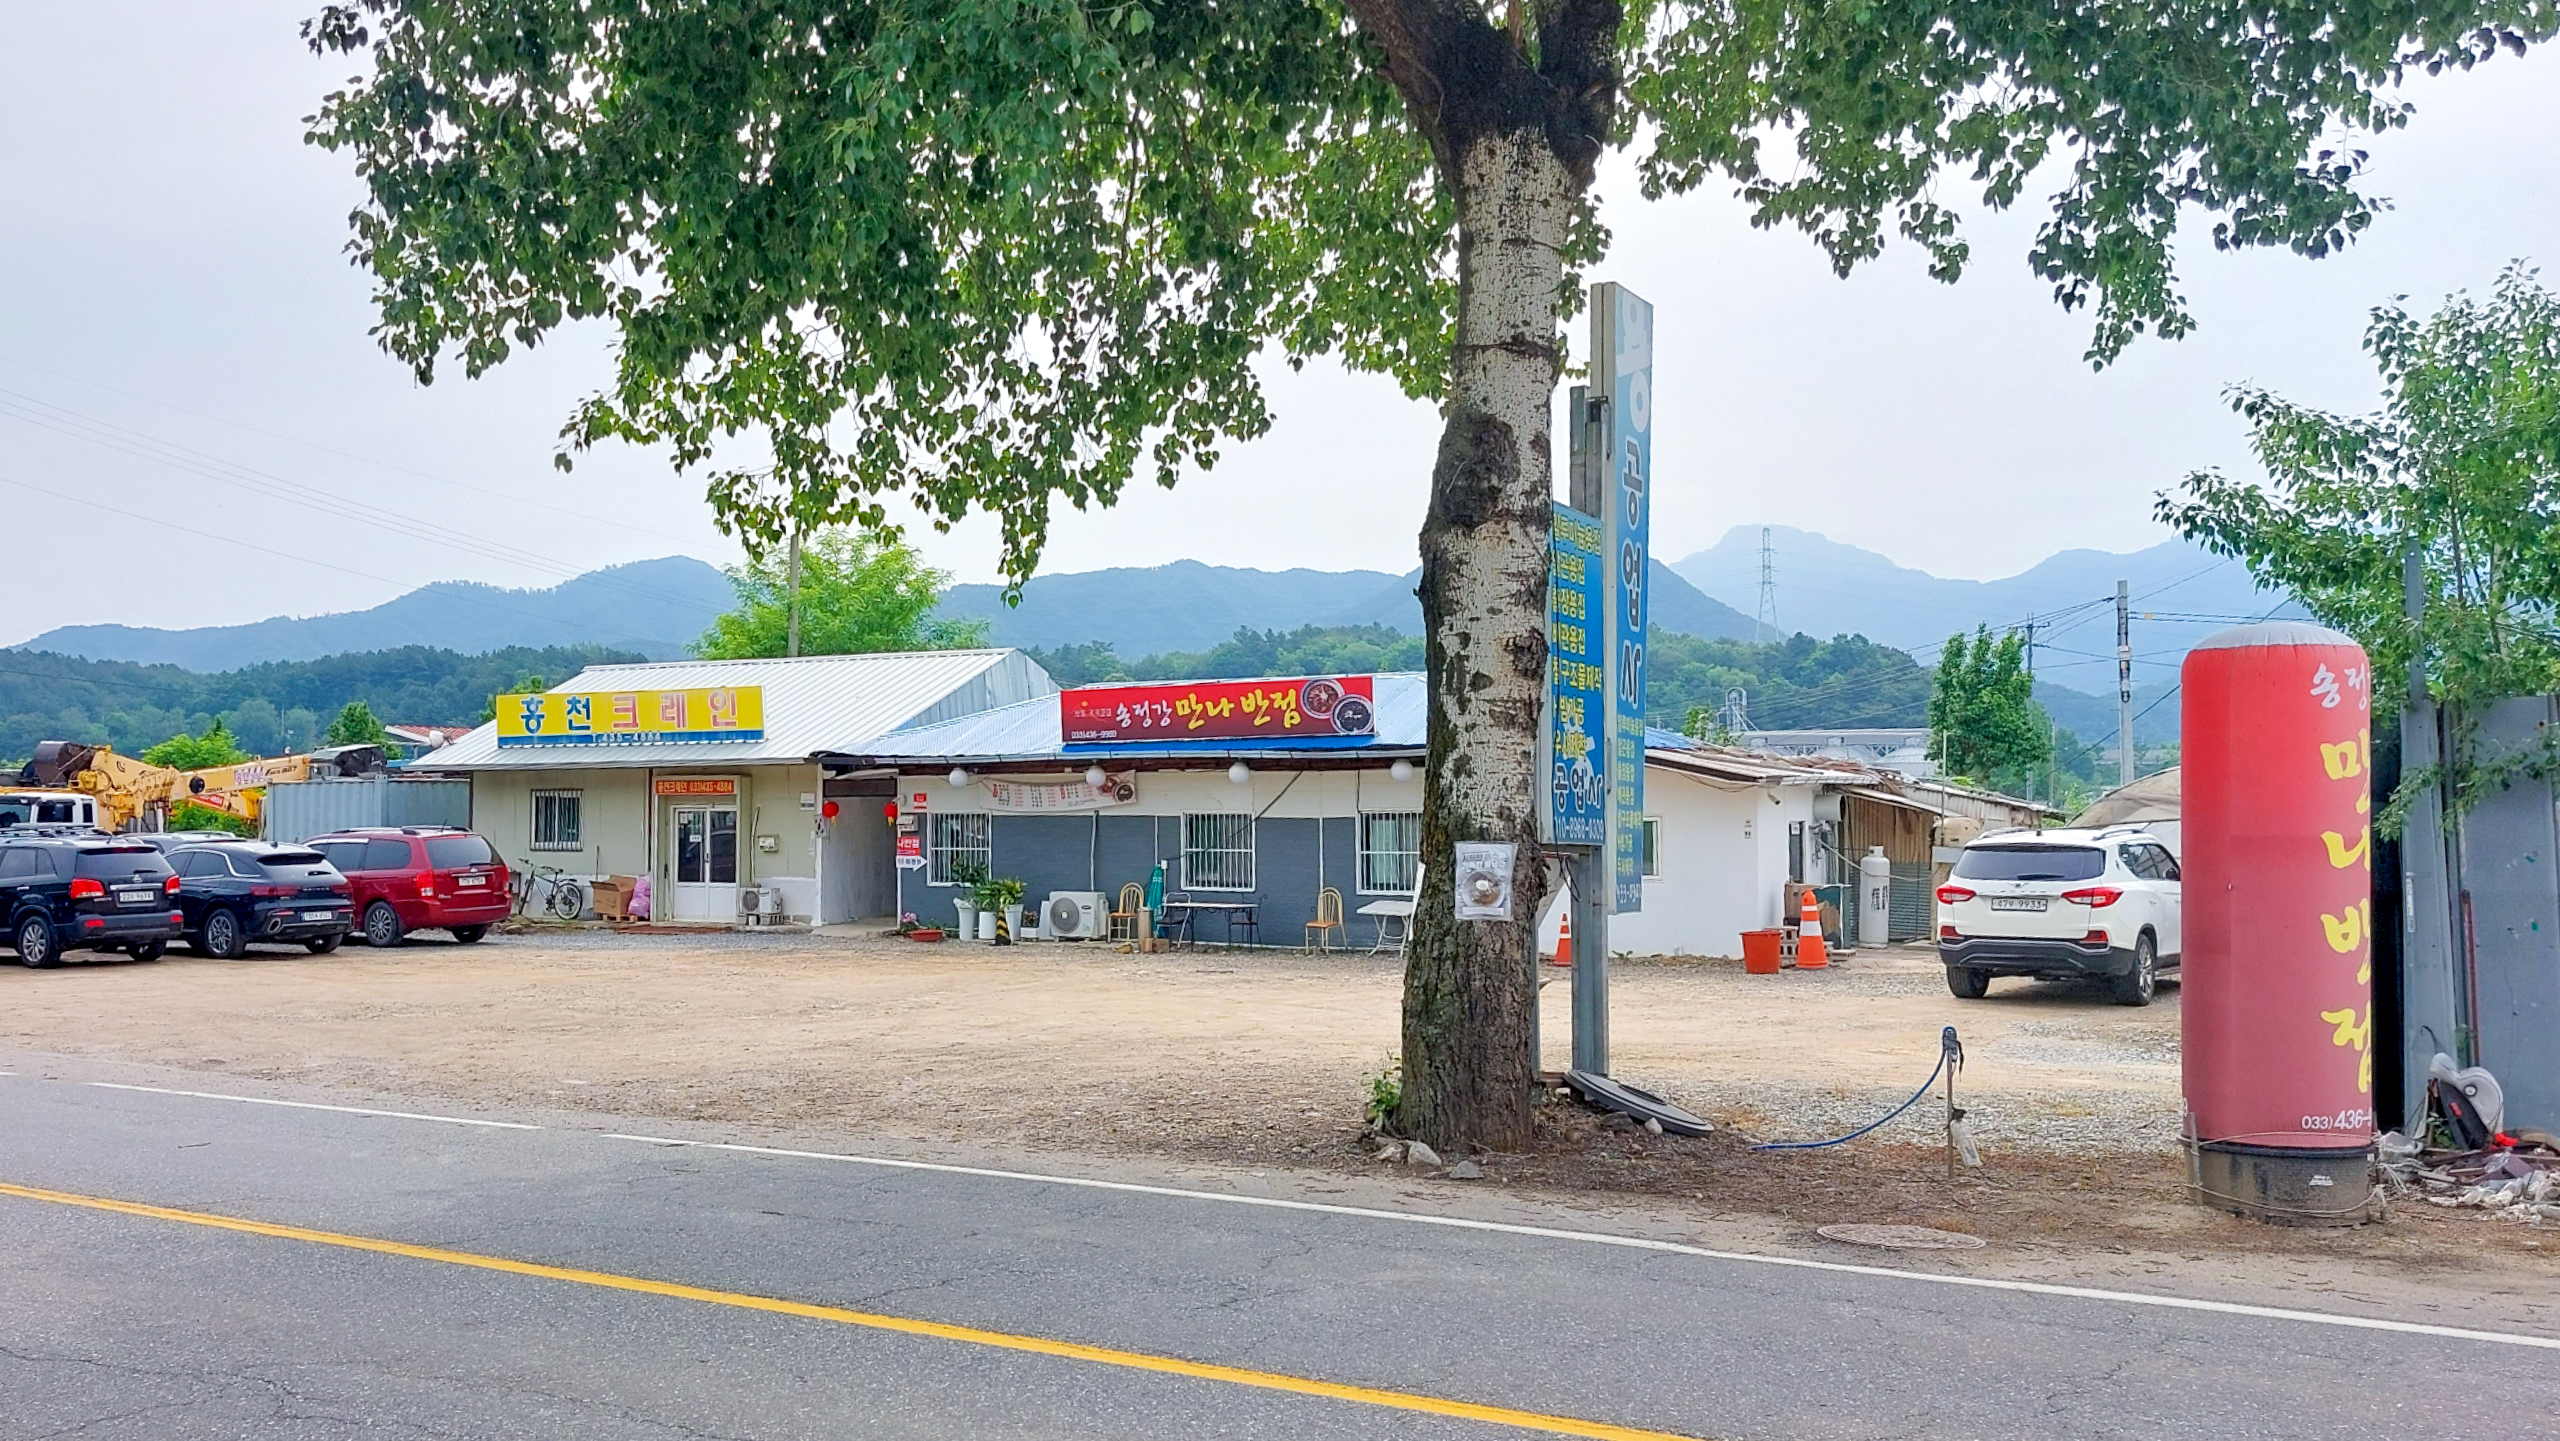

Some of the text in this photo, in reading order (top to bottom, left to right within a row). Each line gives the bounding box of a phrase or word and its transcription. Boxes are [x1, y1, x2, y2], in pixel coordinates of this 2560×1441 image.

[2310, 663, 2370, 711] 송정
[1115, 700, 1172, 728] 송정강
[1554, 763, 1603, 813] 공업사
[2301, 1109, 2371, 1131] 033)436-
